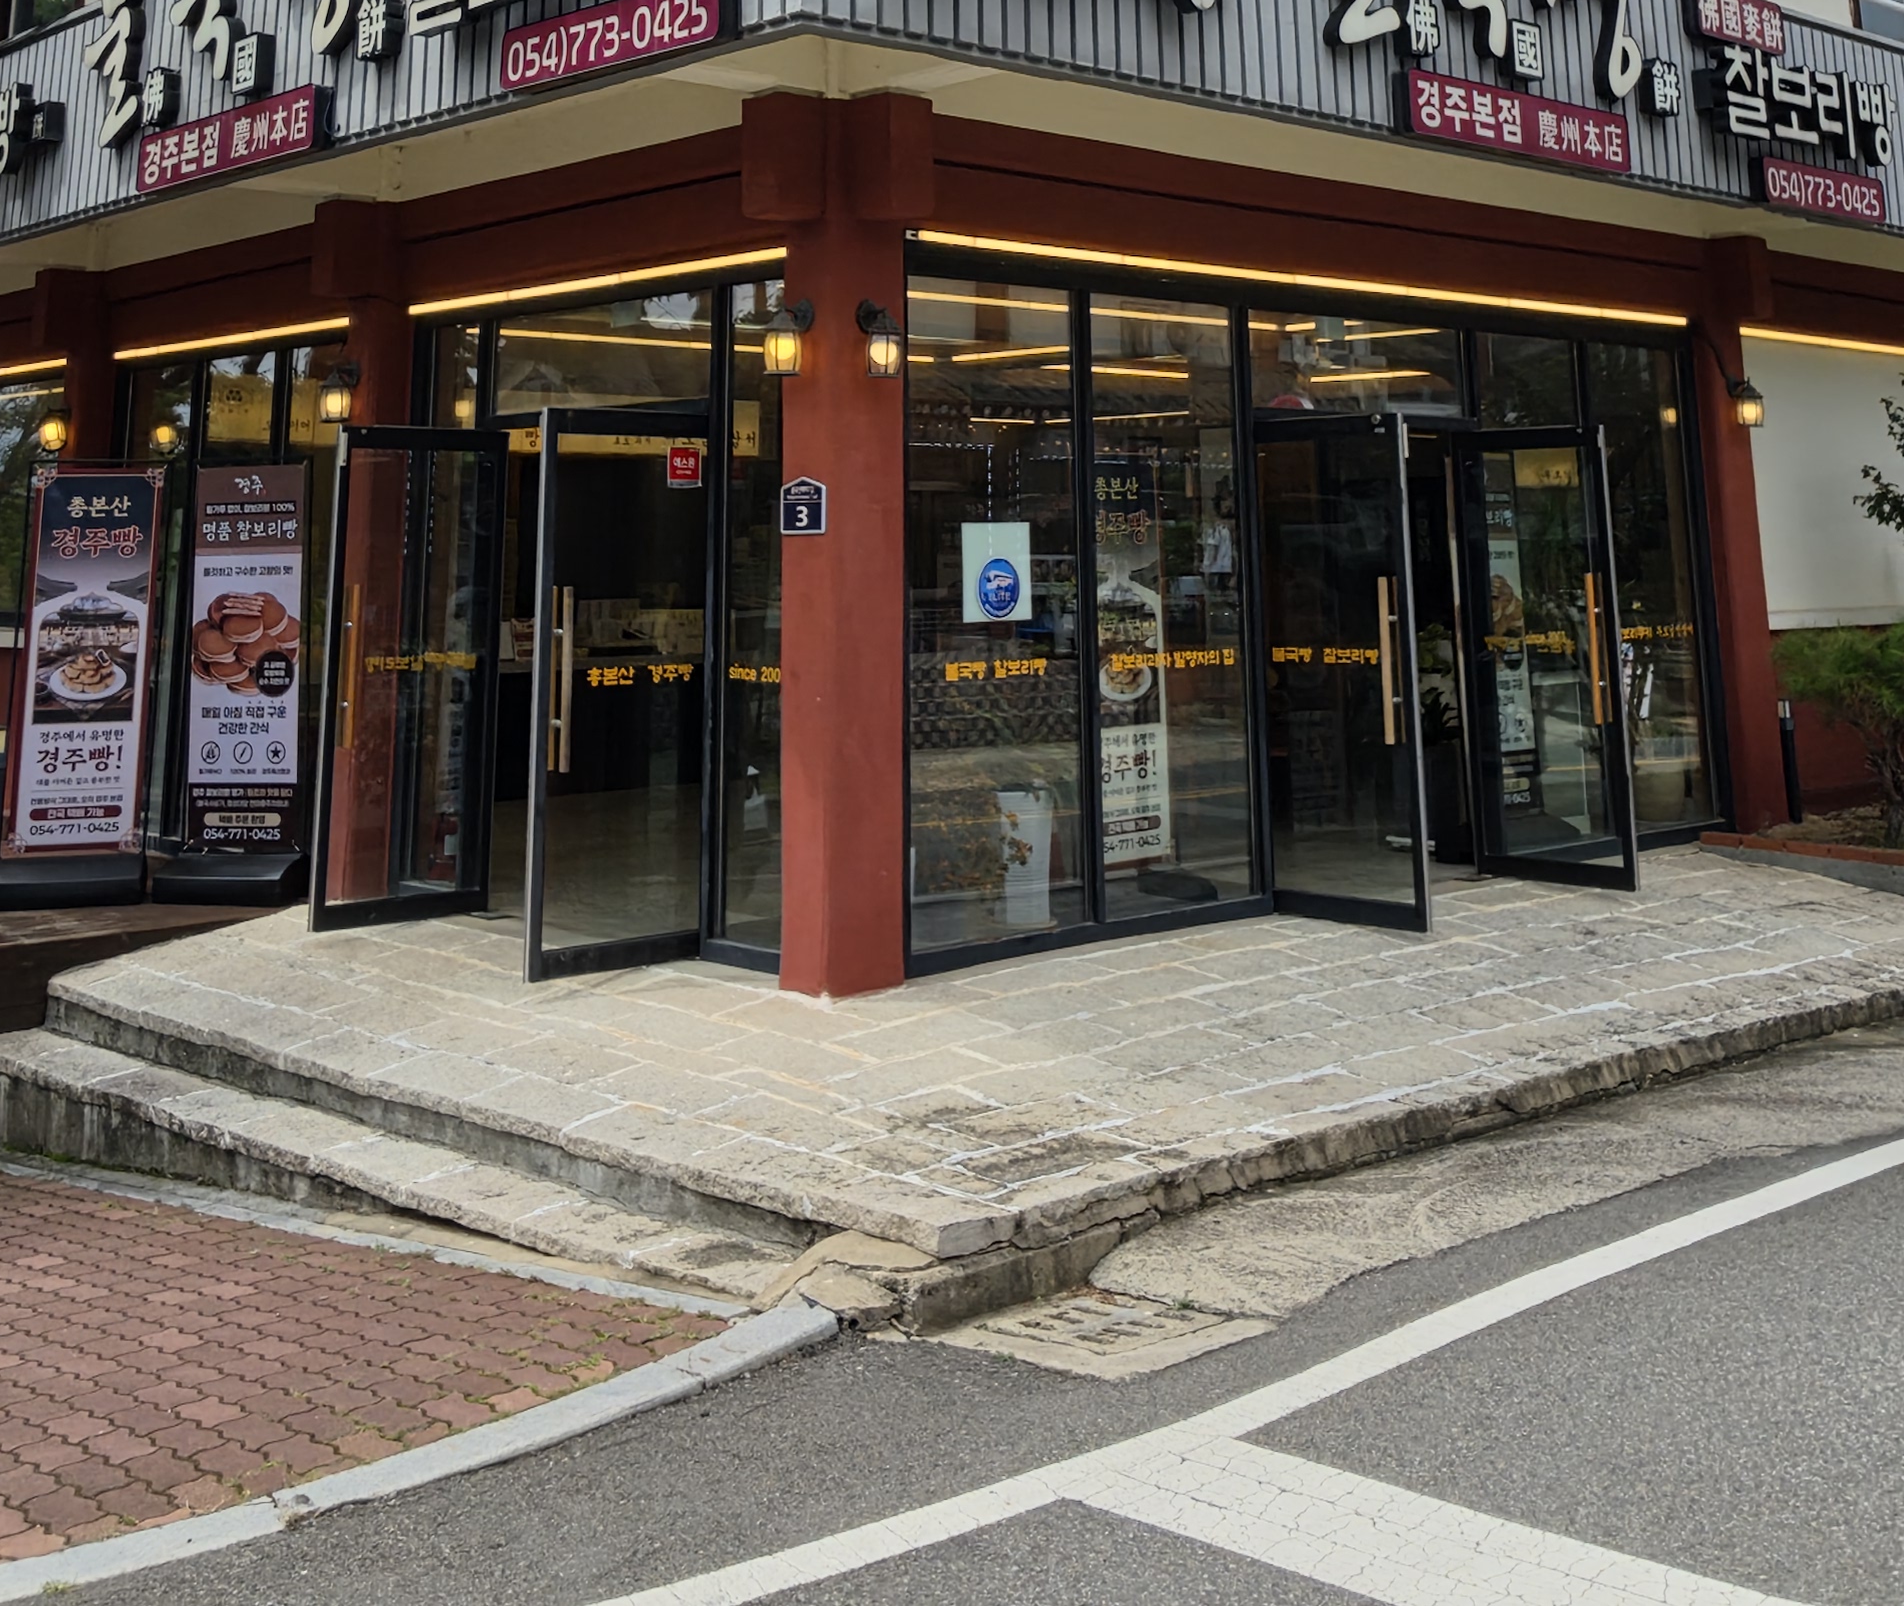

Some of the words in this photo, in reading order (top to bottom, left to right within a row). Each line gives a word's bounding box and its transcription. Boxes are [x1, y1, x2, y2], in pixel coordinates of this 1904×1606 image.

[1723, 45, 1897, 167] 찰보리빵
[1417, 79, 1523, 145] 경주본점
[1538, 110, 1623, 163] 慶州本店
[143, 122, 221, 185] 경주본점
[230, 98, 310, 159] 慶州本店
[1767, 167, 1881, 217] 054)773-0425
[67, 495, 132, 518] 총본산
[272, 502, 295, 512] 100%
[795, 505, 808, 527] 3
[202, 521, 232, 542] 명품
[236, 518, 298, 542] 찰보리빵
[51, 525, 144, 559] 경주빵
[234, 566, 257, 576] 구수한
[1322, 647, 1379, 665] 찰보리빵
[647, 663, 695, 684] 경주빵
[728, 662, 758, 682] since
[760, 666, 782, 684] 200
[993, 658, 1047, 679] 찰보리빵
[201, 706, 221, 719] 매일
[223, 706, 243, 719] 아침
[245, 706, 265, 719] 직접
[267, 705, 287, 719] 구운
[39, 730, 86, 744] 경주에서
[89, 729, 124, 742] 유명한
[218, 722, 248, 735] 건강한
[249, 722, 270, 735] 간식
[36, 744, 124, 773] 경주빵!
[29, 821, 119, 836] 054-771-0425
[203, 828, 281, 840] 054-771-0425
[1103, 834, 1161, 854] 54-771-0425
